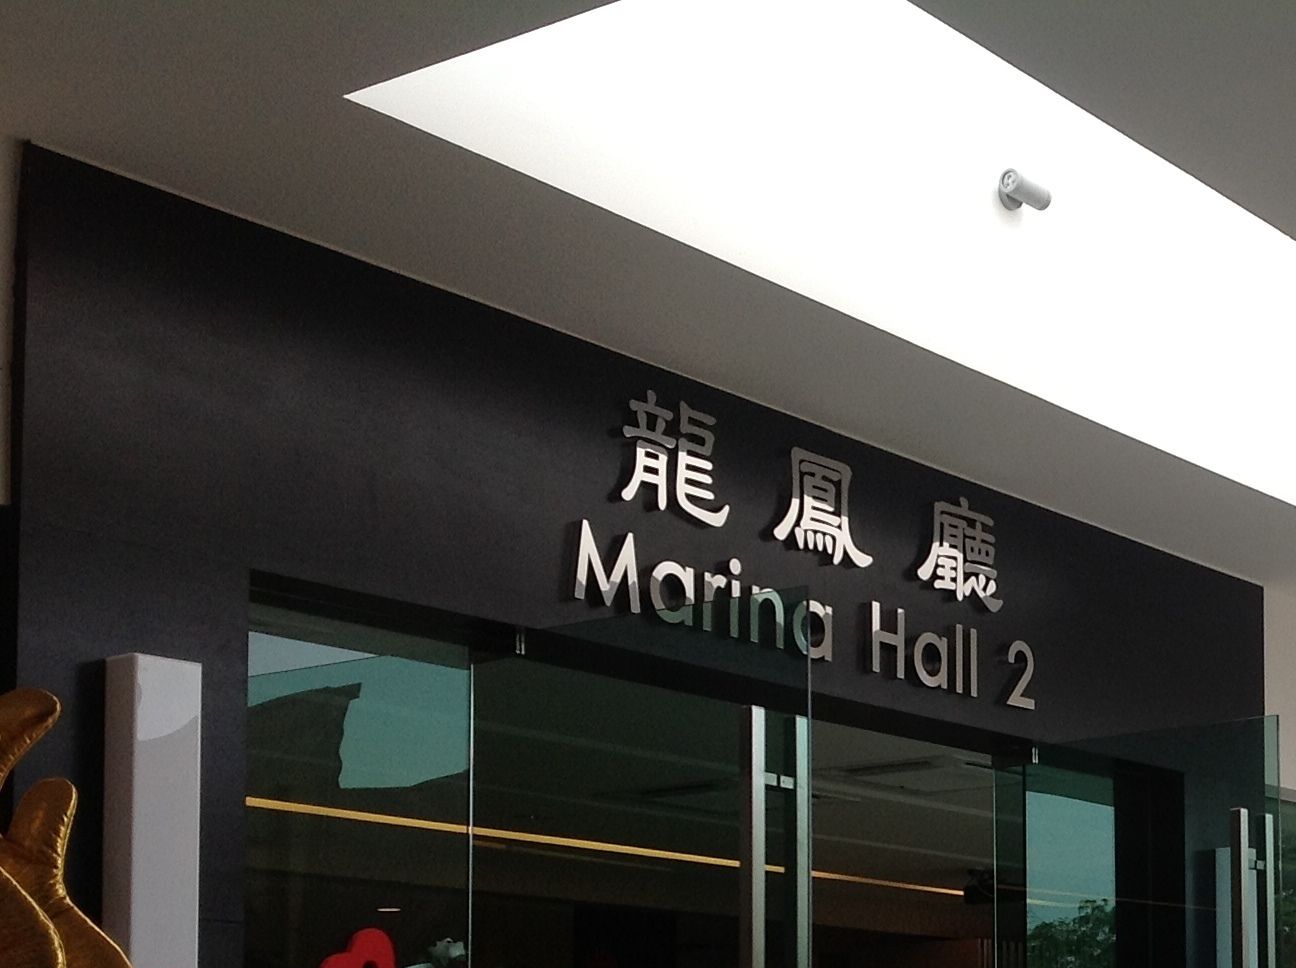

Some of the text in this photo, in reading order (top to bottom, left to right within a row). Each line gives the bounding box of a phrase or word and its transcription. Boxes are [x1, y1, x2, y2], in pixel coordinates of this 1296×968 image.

[621, 390, 1003, 612] 龍鳳廳
[574, 519, 1036, 710] Marina Hall 2
